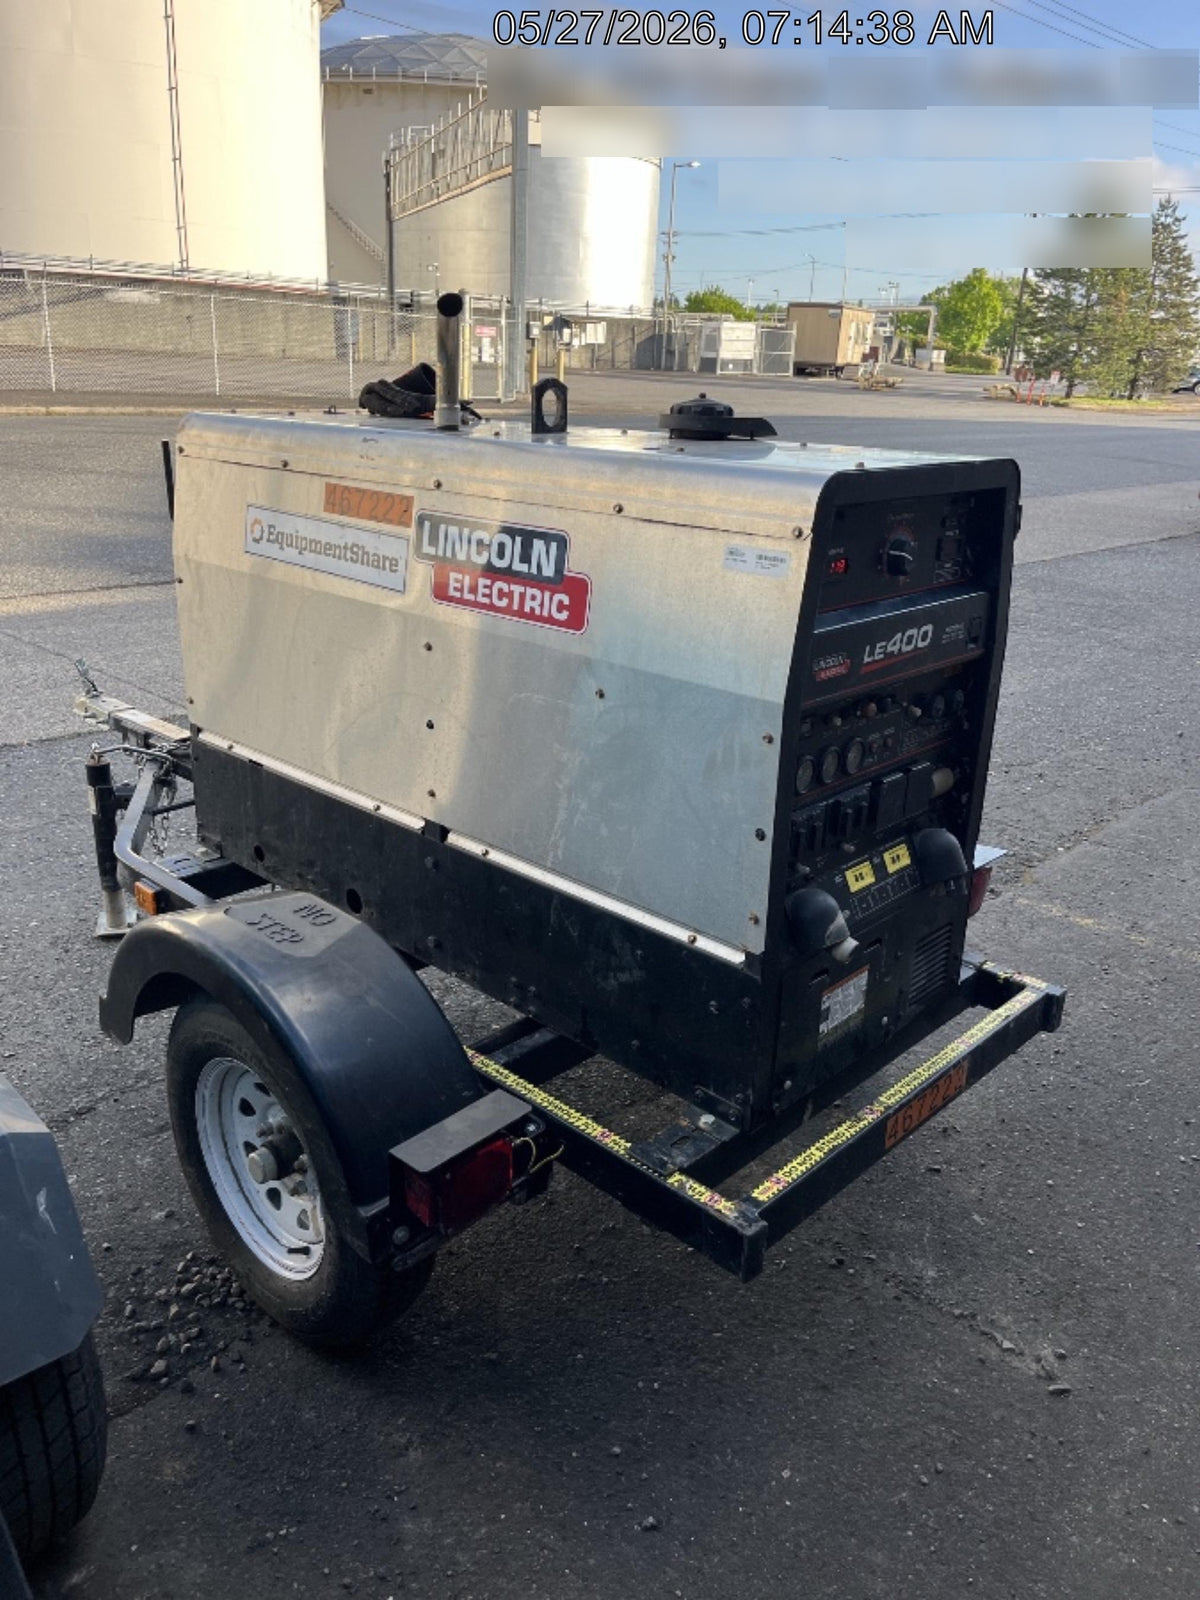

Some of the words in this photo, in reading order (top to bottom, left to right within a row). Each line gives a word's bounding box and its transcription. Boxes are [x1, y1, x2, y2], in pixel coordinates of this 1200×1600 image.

[266, 524, 400, 573] EquipmentShare
[422, 520, 557, 578] LINCOLN
[448, 572, 569, 620] ELECTRIC
[863, 624, 934, 664] LE400
